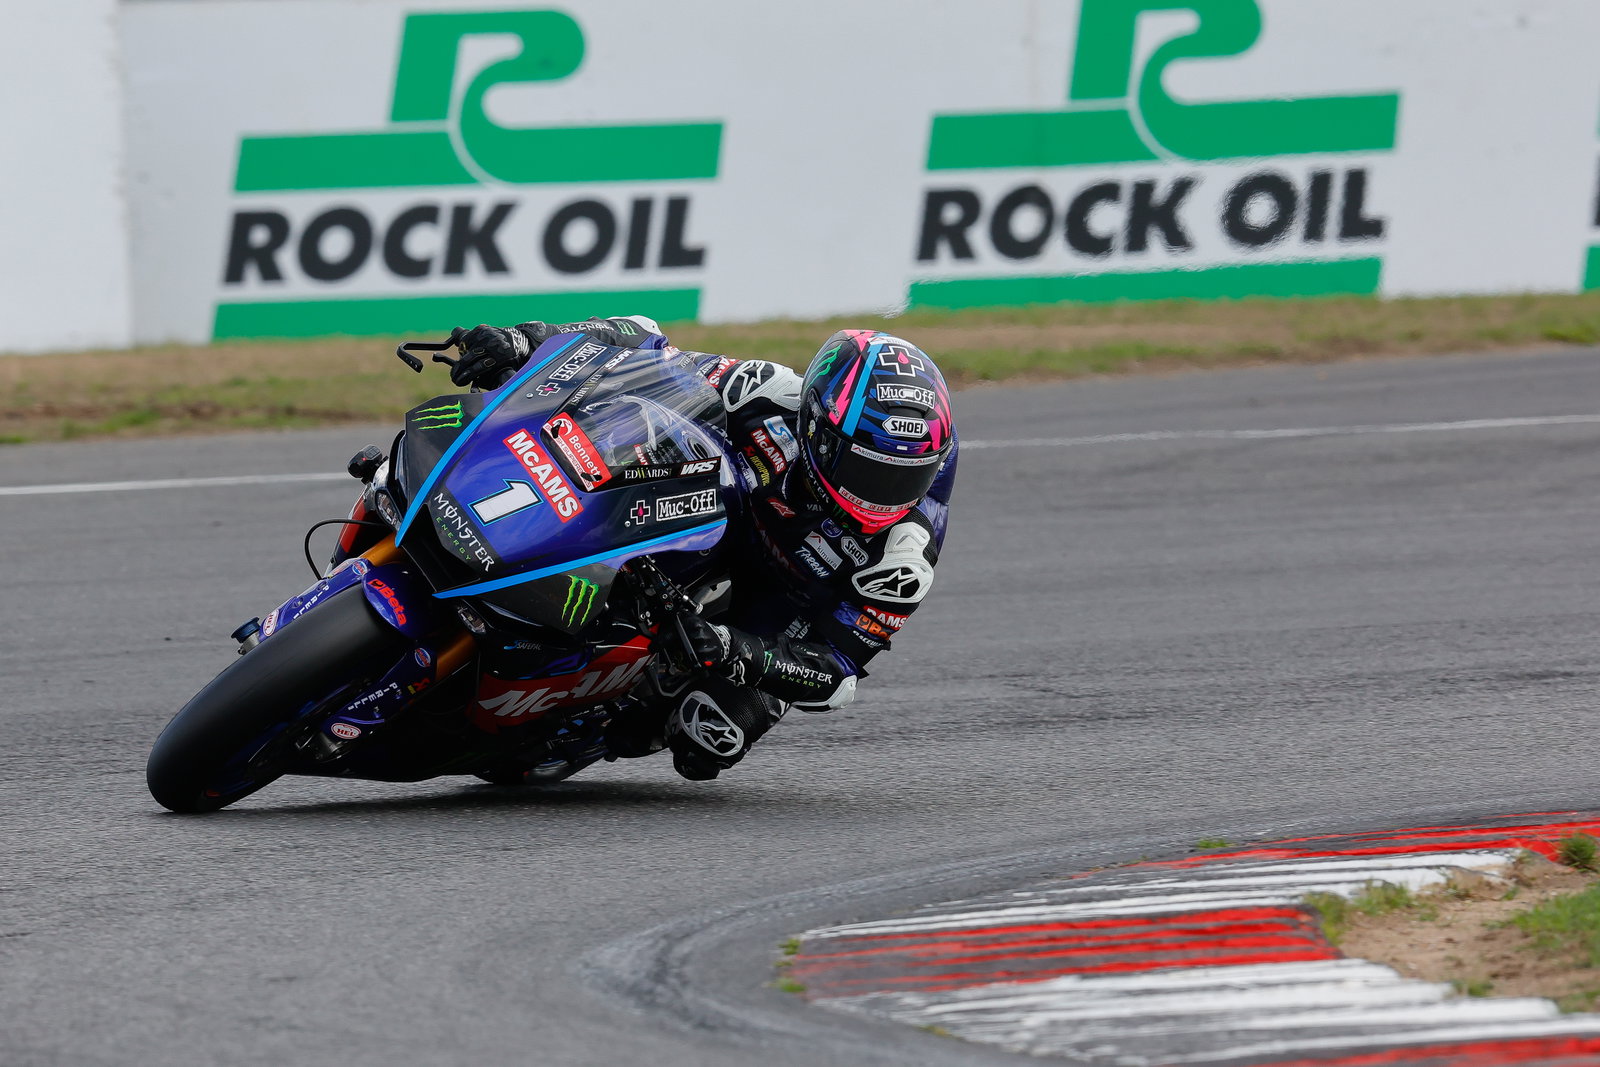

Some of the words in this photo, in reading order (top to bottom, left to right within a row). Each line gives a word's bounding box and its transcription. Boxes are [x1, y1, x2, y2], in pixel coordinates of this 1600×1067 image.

[917, 176, 1199, 262] ROCK
[1221, 168, 1384, 247] OIL
[223, 202, 519, 284] ROCK
[542, 195, 708, 274] OIL
[890, 420, 924, 435] SHOEI
[680, 460, 718, 476] WRS
[752, 429, 785, 472] McAMS
[468, 479, 544, 526] 1
[659, 491, 714, 518] Muc-Off
[434, 492, 495, 572] MONSTER
[379, 586, 407, 627] Beta
[775, 660, 833, 685] MONSTER
